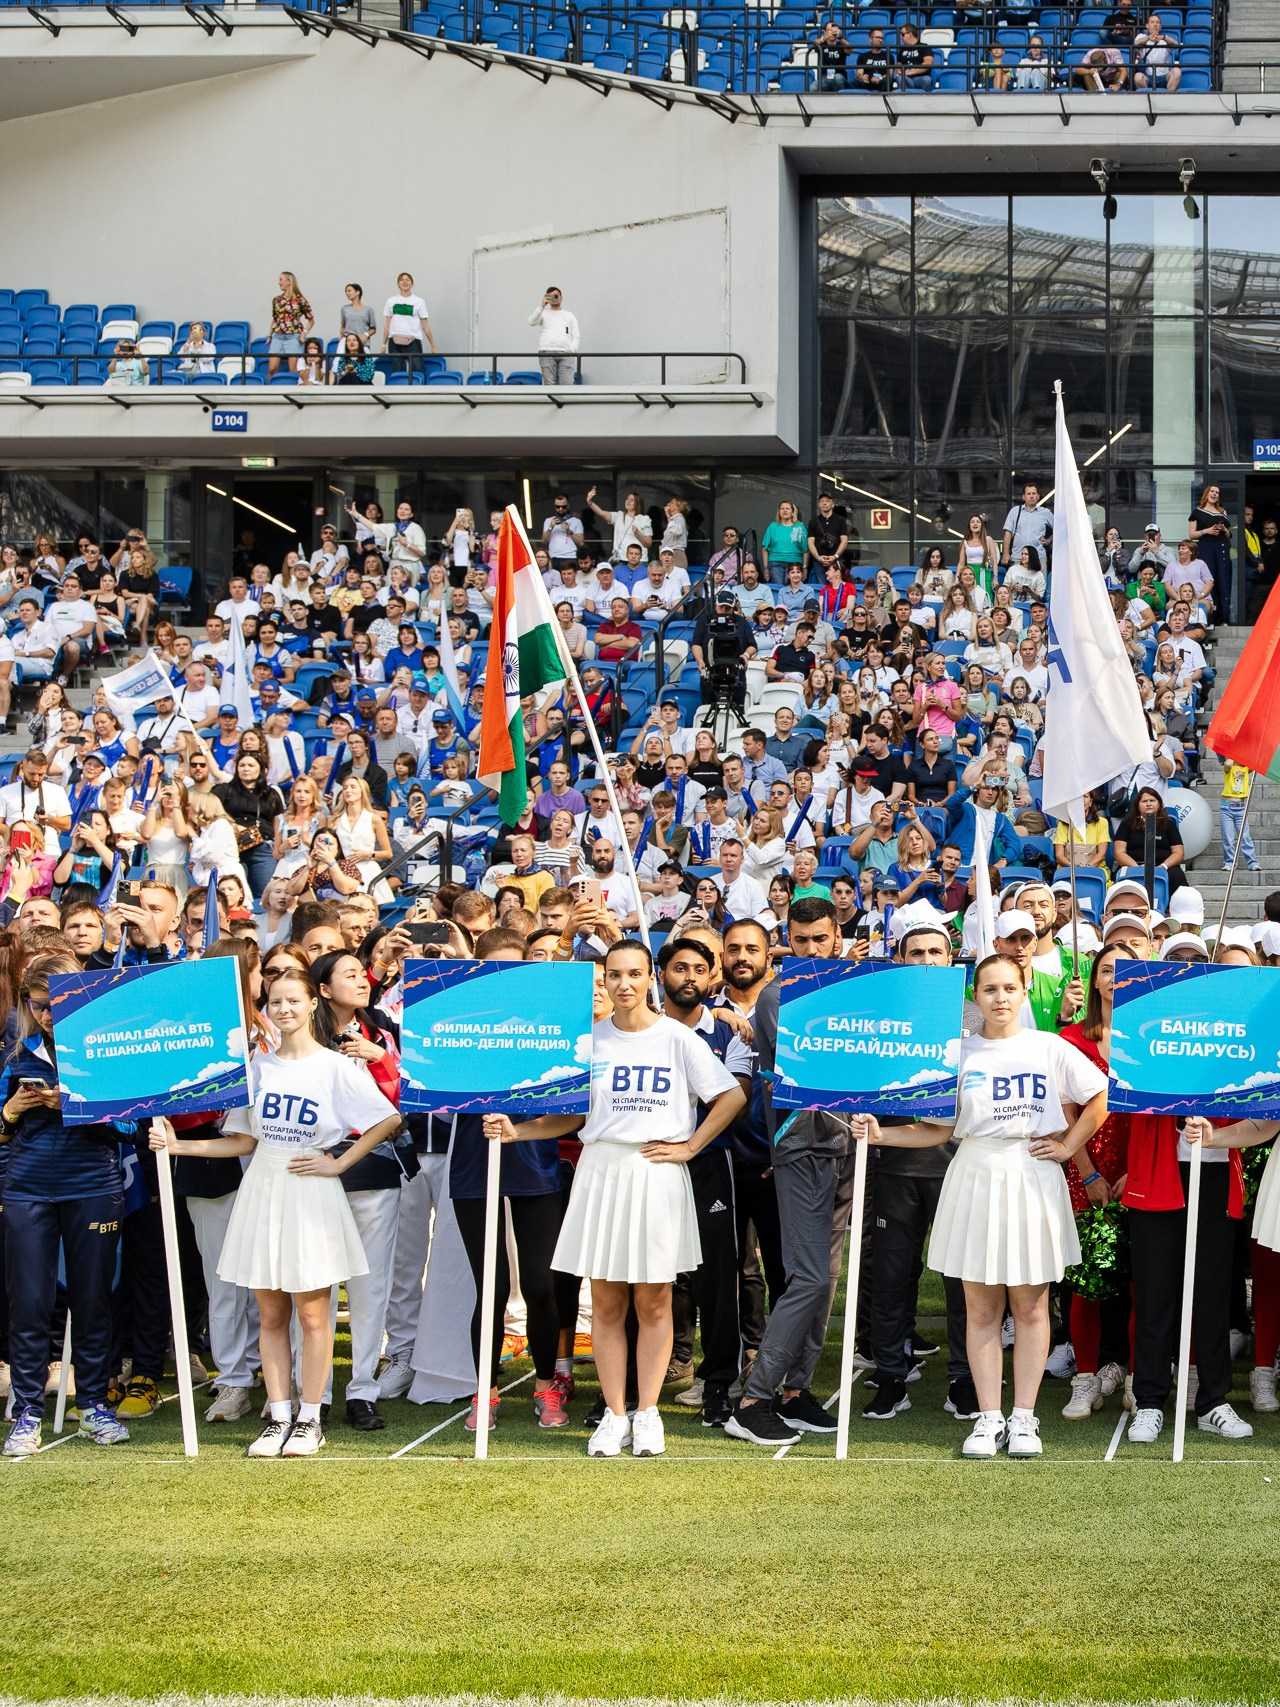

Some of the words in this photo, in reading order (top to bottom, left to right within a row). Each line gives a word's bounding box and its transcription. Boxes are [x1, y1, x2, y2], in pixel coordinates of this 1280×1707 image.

[602, 600, 612, 608] ВТ
[85, 1029, 143, 1046] ФИЛИАЛ
[144, 1026, 189, 1040] БАНКА
[189, 1023, 213, 1035] ВТБ
[433, 1023, 492, 1035] ФИЛИАЛ
[493, 1023, 537, 1035] БАНКА
[538, 1024, 562, 1036] ВТБ
[827, 1017, 878, 1034] БАНК
[879, 1020, 912, 1035] ВТБ
[1161, 1020, 1211, 1036] БАНК
[1213, 1022, 1246, 1038] ВТБ
[86, 1048, 95, 1060] В
[164, 1035, 215, 1054] (КИТАЙ)
[423, 1037, 432, 1048] В
[434, 1036, 514, 1051] Г.НЬЮ-ДЕЛИ
[516, 1037, 571, 1051] (ИНДИЯ)
[793, 1036, 943, 1062] (АЗЕРБАЙДЖАН)
[1149, 1041, 1255, 1062] (БЕЛАРУСЬ)
[612, 1065, 672, 1093] ВТБ
[993, 1073, 1046, 1101] ВТБ
[262, 1091, 320, 1126] ВТБ
[709, 1205, 727, 1213] adidas
[100, 1221, 118, 1234] ВТБ
